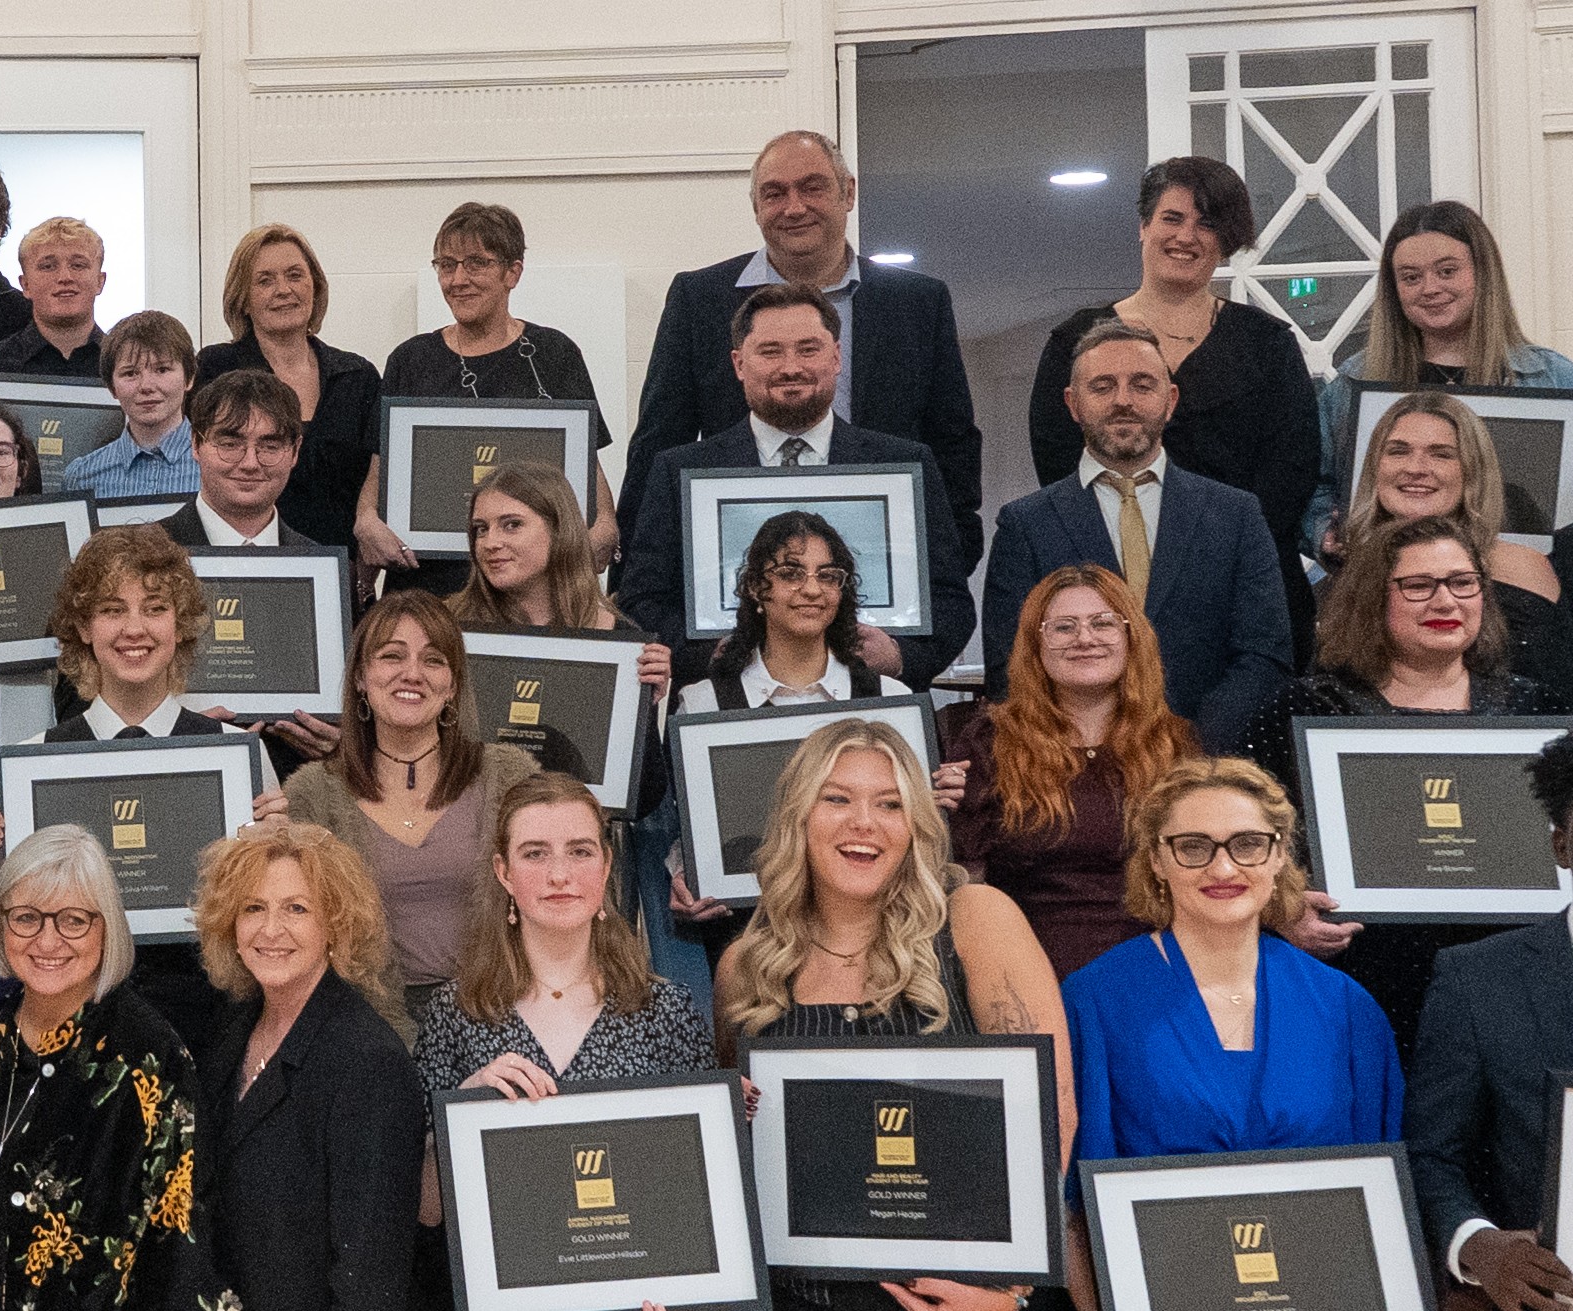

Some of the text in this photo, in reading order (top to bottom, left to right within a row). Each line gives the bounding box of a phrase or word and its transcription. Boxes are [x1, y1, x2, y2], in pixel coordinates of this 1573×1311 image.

[867, 1190, 927, 1200] GOLD WINNER
[570, 1231, 629, 1243] GOLD WINNER
